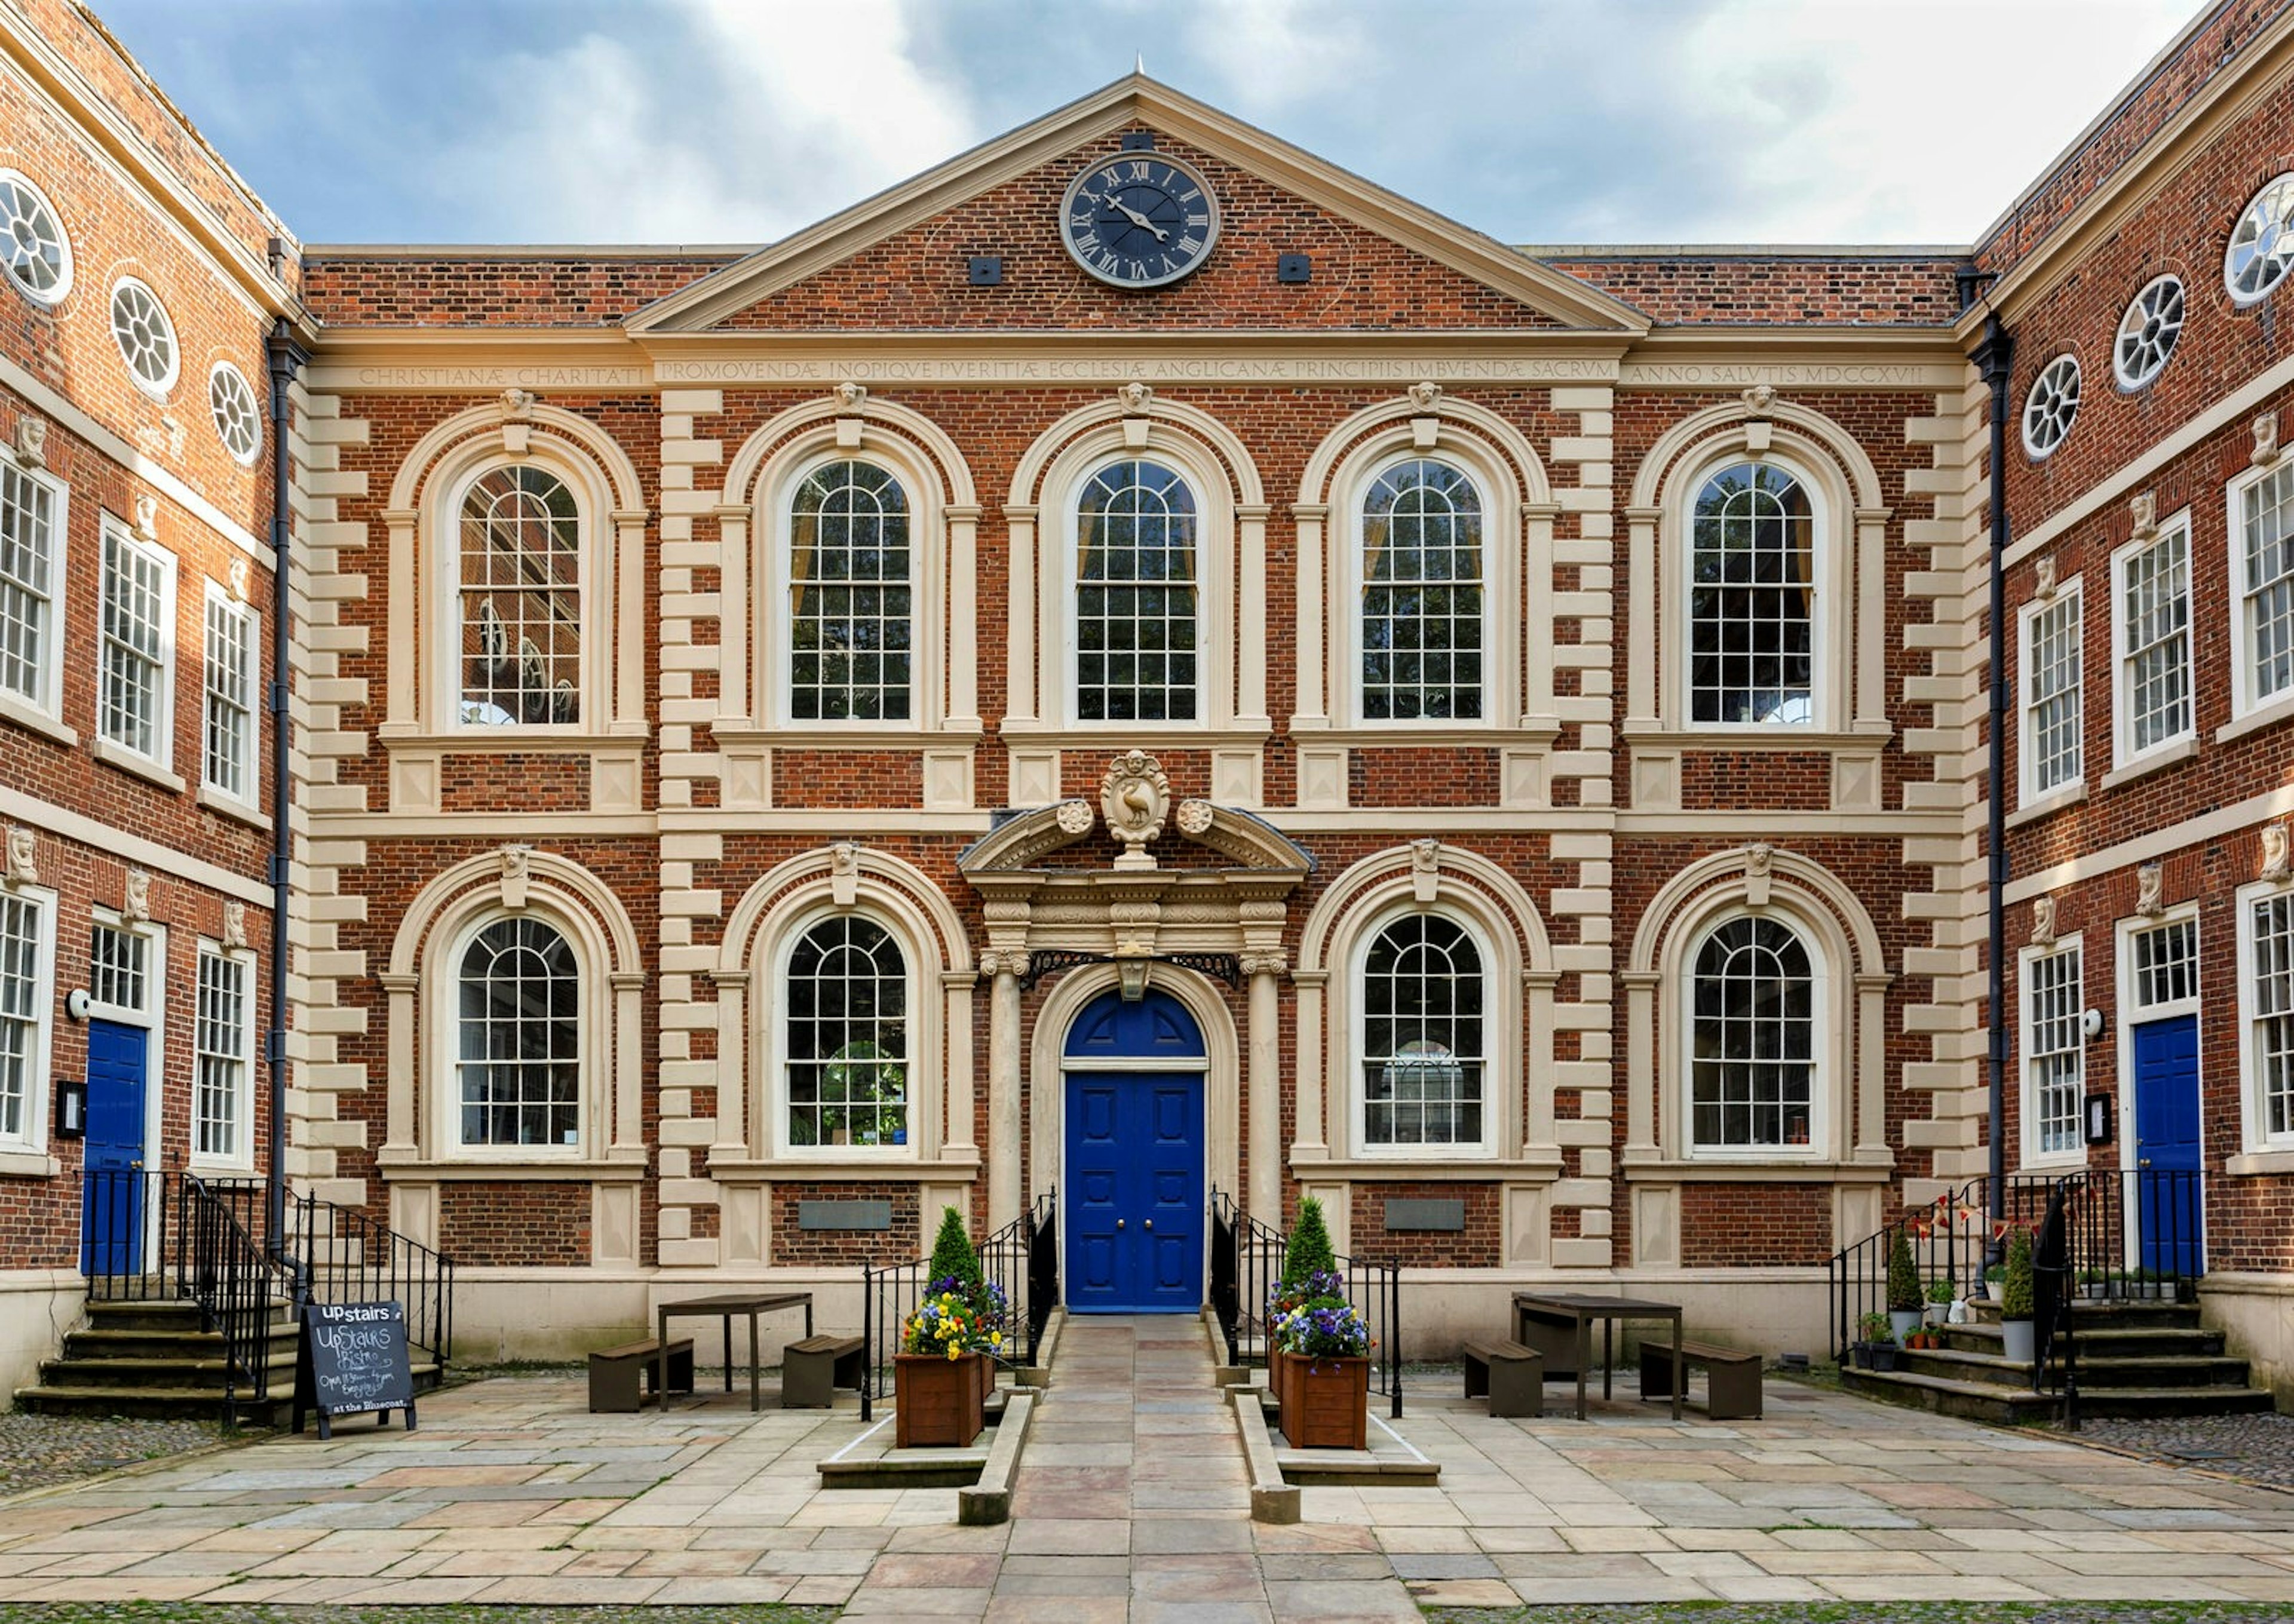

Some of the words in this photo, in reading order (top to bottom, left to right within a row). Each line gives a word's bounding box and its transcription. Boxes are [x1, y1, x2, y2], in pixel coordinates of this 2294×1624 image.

[1101, 167, 1122, 188] XI
[1130, 162, 1149, 180] XII
[1162, 169, 1177, 186] I
[1078, 187, 1101, 204] X
[1179, 188, 1201, 202] II
[1072, 212, 1091, 228] IX
[1187, 214, 1207, 227] III
[1075, 231, 1100, 259] VIII
[1177, 235, 1203, 256] IIII
[1097, 251, 1119, 276] VII
[1130, 262, 1151, 279] VI
[1163, 255, 1179, 273] V
[517, 368, 643, 385] CHARITATI
[1295, 361, 1403, 377] PRINCIPIIS
[1631, 366, 1701, 382] ANNO
[1805, 366, 1922, 383] MDCCXVII
[337, 1350, 378, 1371] Bistro
[333, 1405, 345, 1413] at
[345, 1402, 362, 1411] the
